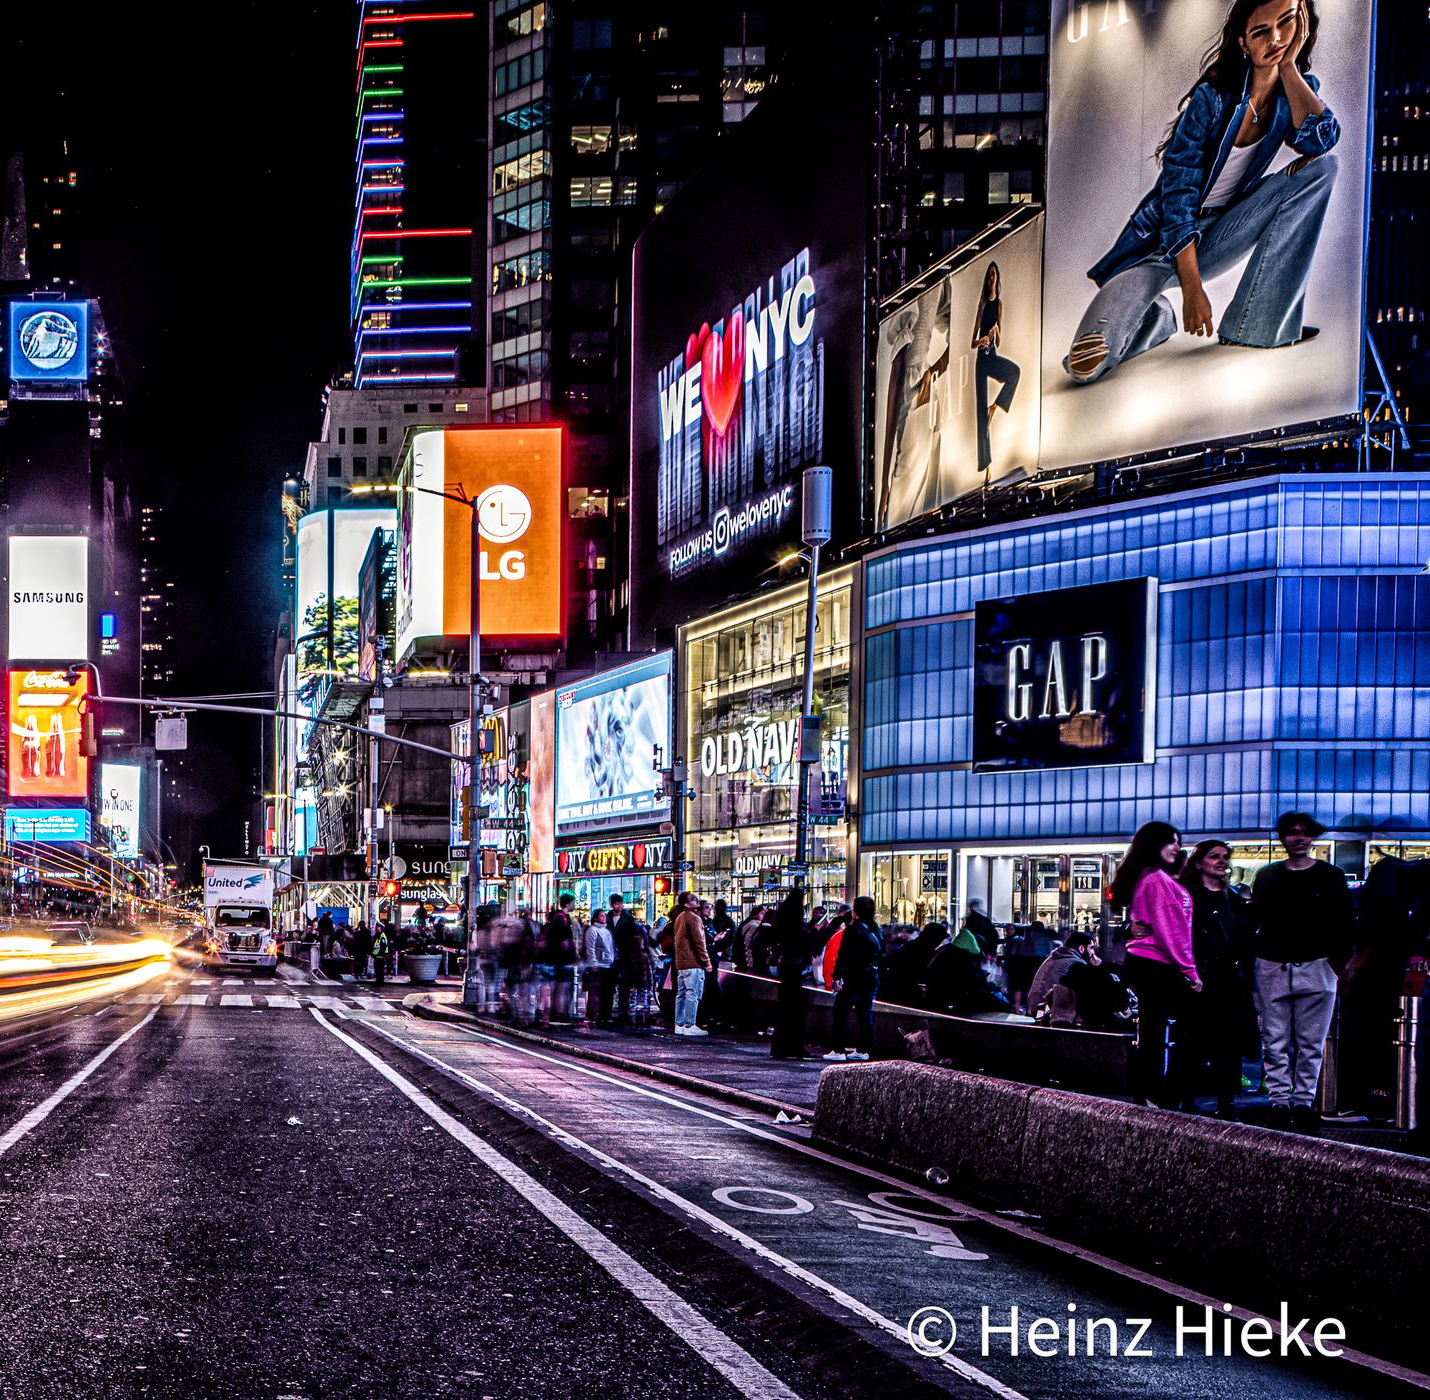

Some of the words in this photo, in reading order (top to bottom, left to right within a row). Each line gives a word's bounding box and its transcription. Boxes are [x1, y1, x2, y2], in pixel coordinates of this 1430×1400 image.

[659, 360, 703, 443] WE
[745, 273, 816, 384] NYC
[671, 536, 700, 569] FOLLOW
[701, 530, 713, 551] US
[730, 487, 791, 537] welovenyc
[479, 550, 526, 581] LG
[13, 592, 84, 604] SAMSUNG
[1008, 636, 1108, 721] GAP
[701, 731, 743, 777] OLD
[744, 718, 800, 769] NAV
[492, 819, 500, 828] W
[503, 819, 514, 828] 44
[588, 846, 627, 872] GIFTS
[628, 845, 633, 869] I
[644, 842, 667, 868] NY
[736, 856, 754, 874] OLD
[754, 854, 783, 872] NAVY
[208, 877, 243, 888] United
